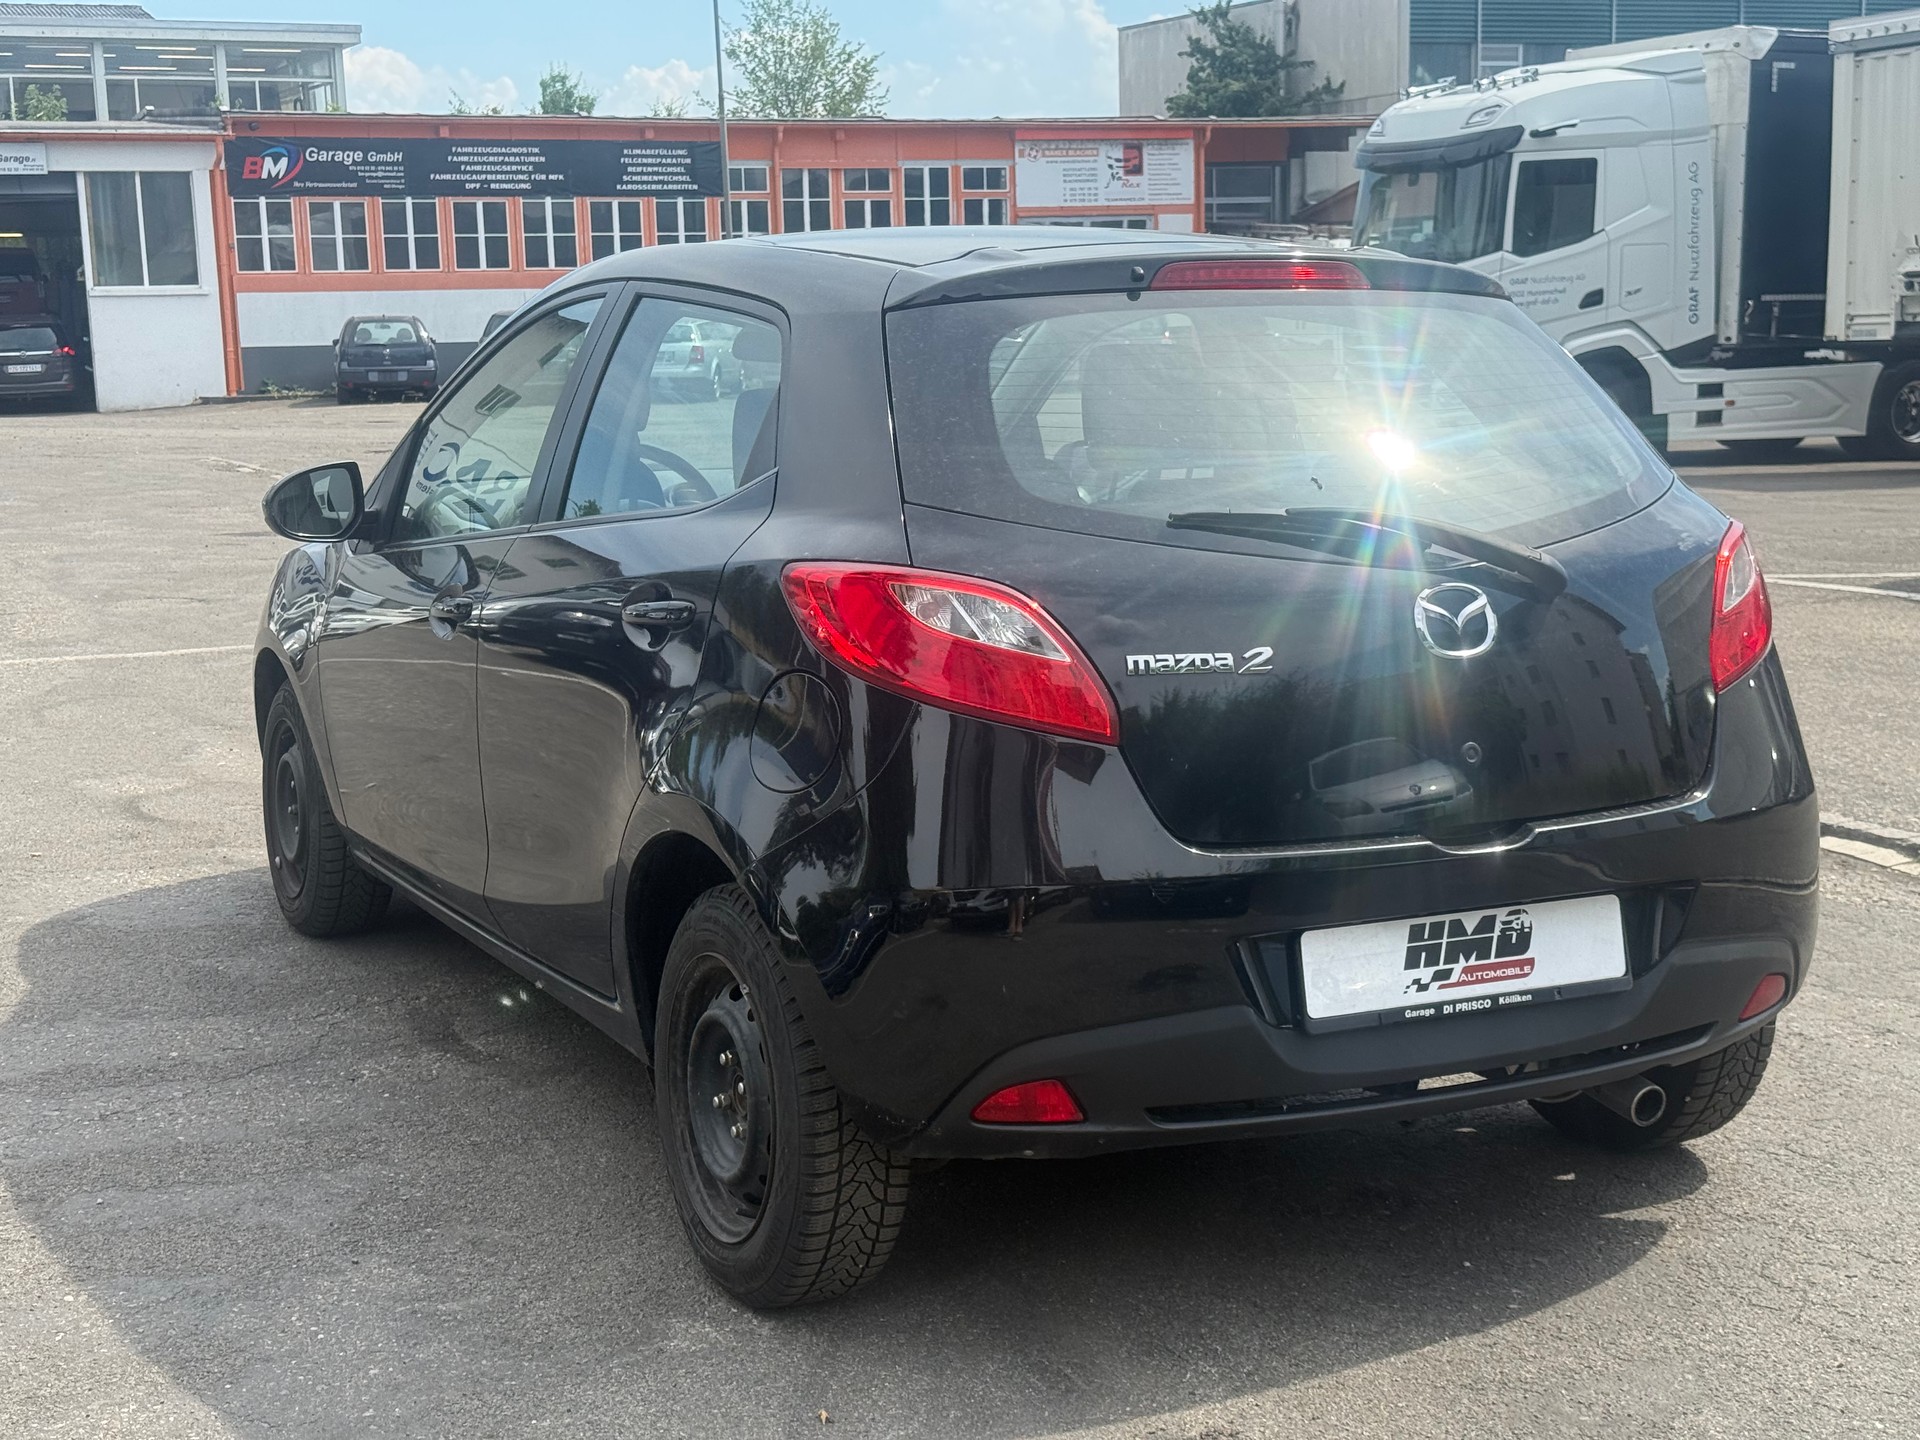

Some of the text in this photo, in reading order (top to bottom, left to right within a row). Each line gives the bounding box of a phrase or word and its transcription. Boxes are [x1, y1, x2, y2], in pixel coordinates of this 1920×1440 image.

[241, 156, 288, 180] BM
[305, 147, 403, 165] Garage GmbH
[1687, 161, 1704, 324] GRAF Nutzfahrzeug AG
[1126, 646, 1273, 676] mazda 2
[1403, 908, 1534, 971] HMD
[1458, 965, 1531, 983] AUTOMOBILE
[1404, 994, 1532, 1018] Garage DI PRISCO Kölliken
